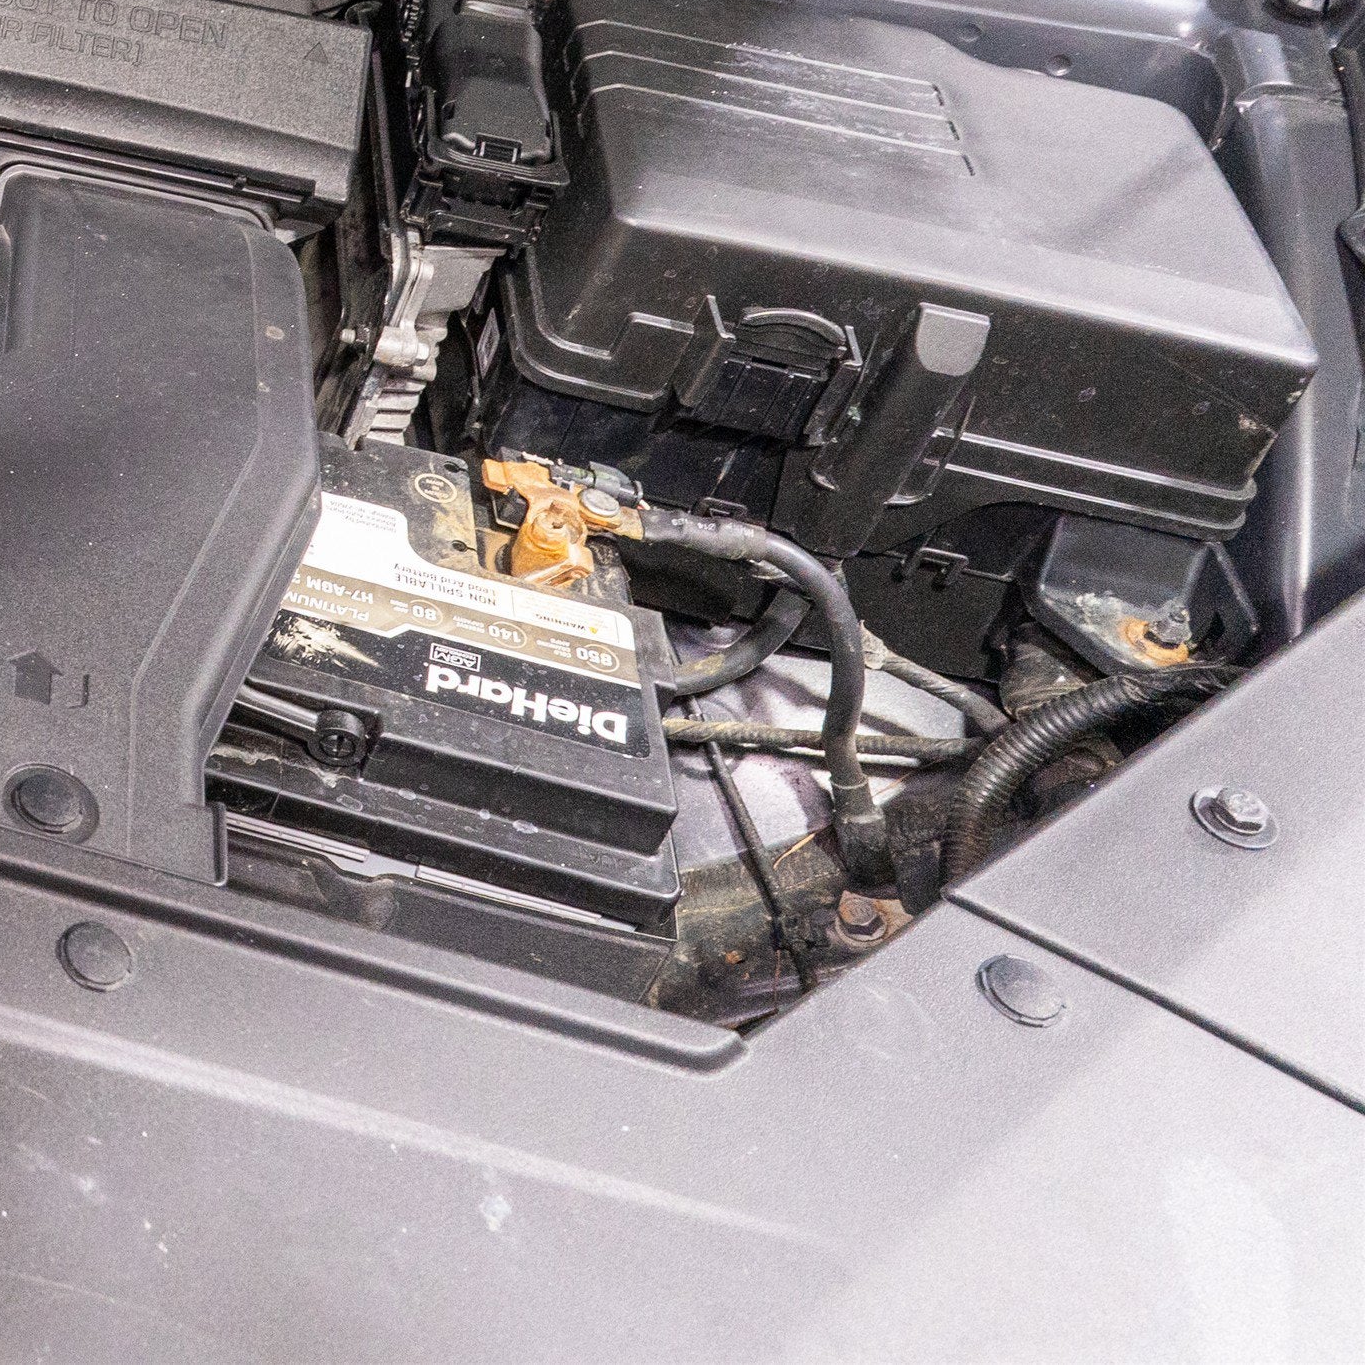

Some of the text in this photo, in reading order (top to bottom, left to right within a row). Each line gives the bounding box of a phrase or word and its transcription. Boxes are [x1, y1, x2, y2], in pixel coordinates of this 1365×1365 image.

[127, 4, 229, 49] OPEN
[306, 575, 373, 604] H7-AGM
[394, 563, 496, 596] Lead Acid Battery
[283, 591, 369, 622] PLATINUM
[412, 604, 437, 621] 80
[488, 625, 521, 643] 140
[433, 650, 477, 670] AGM
[575, 647, 613, 667] 850
[426, 664, 628, 745] DieHard
